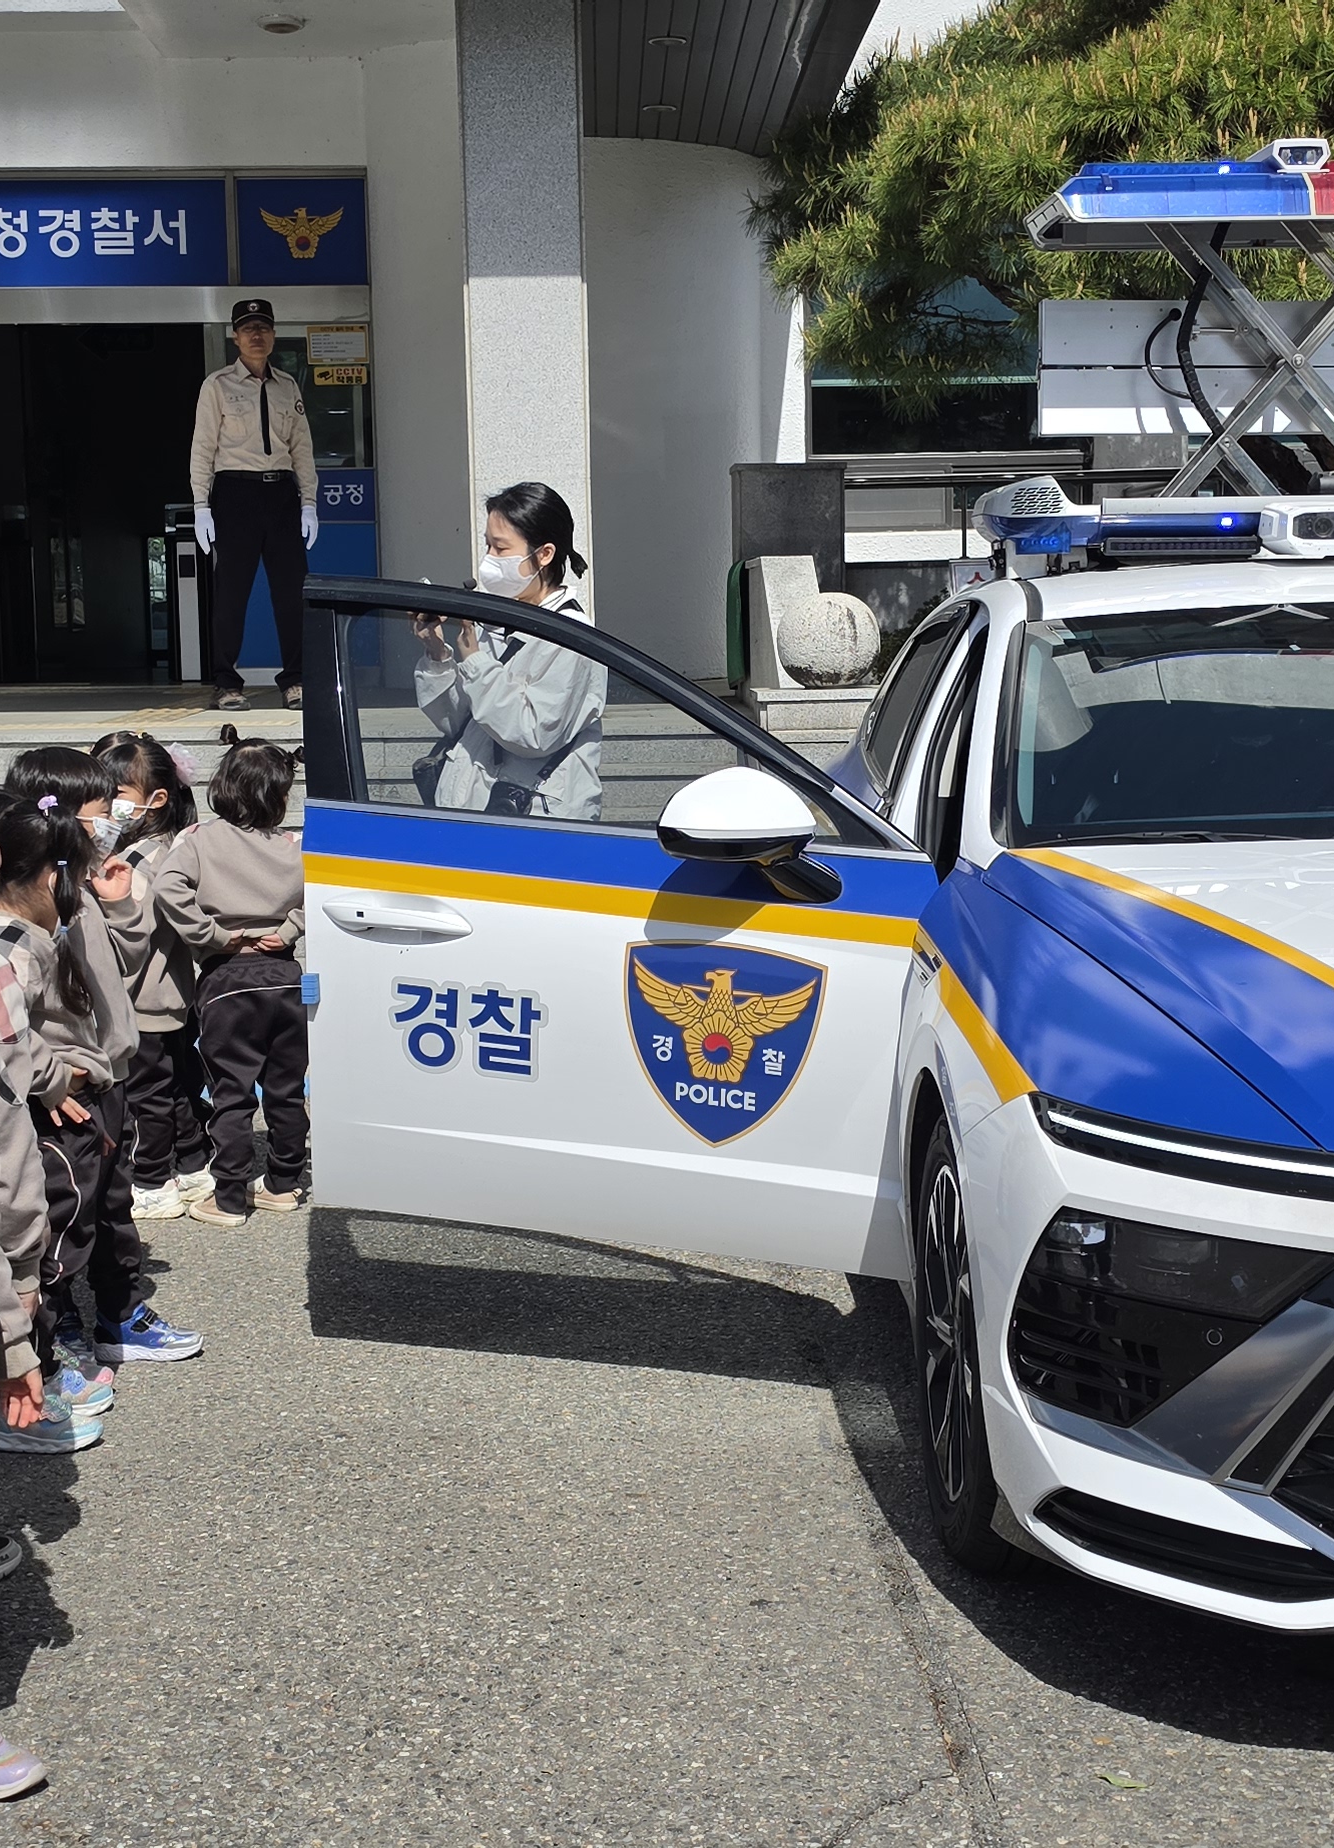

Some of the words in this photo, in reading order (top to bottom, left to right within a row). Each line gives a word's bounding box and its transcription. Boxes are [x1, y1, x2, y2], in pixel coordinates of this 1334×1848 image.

[336, 368, 363, 376] CCTV
[323, 484, 364, 505] 공정
[391, 981, 542, 1077] 경찰
[674, 1080, 757, 1113] POLICE
